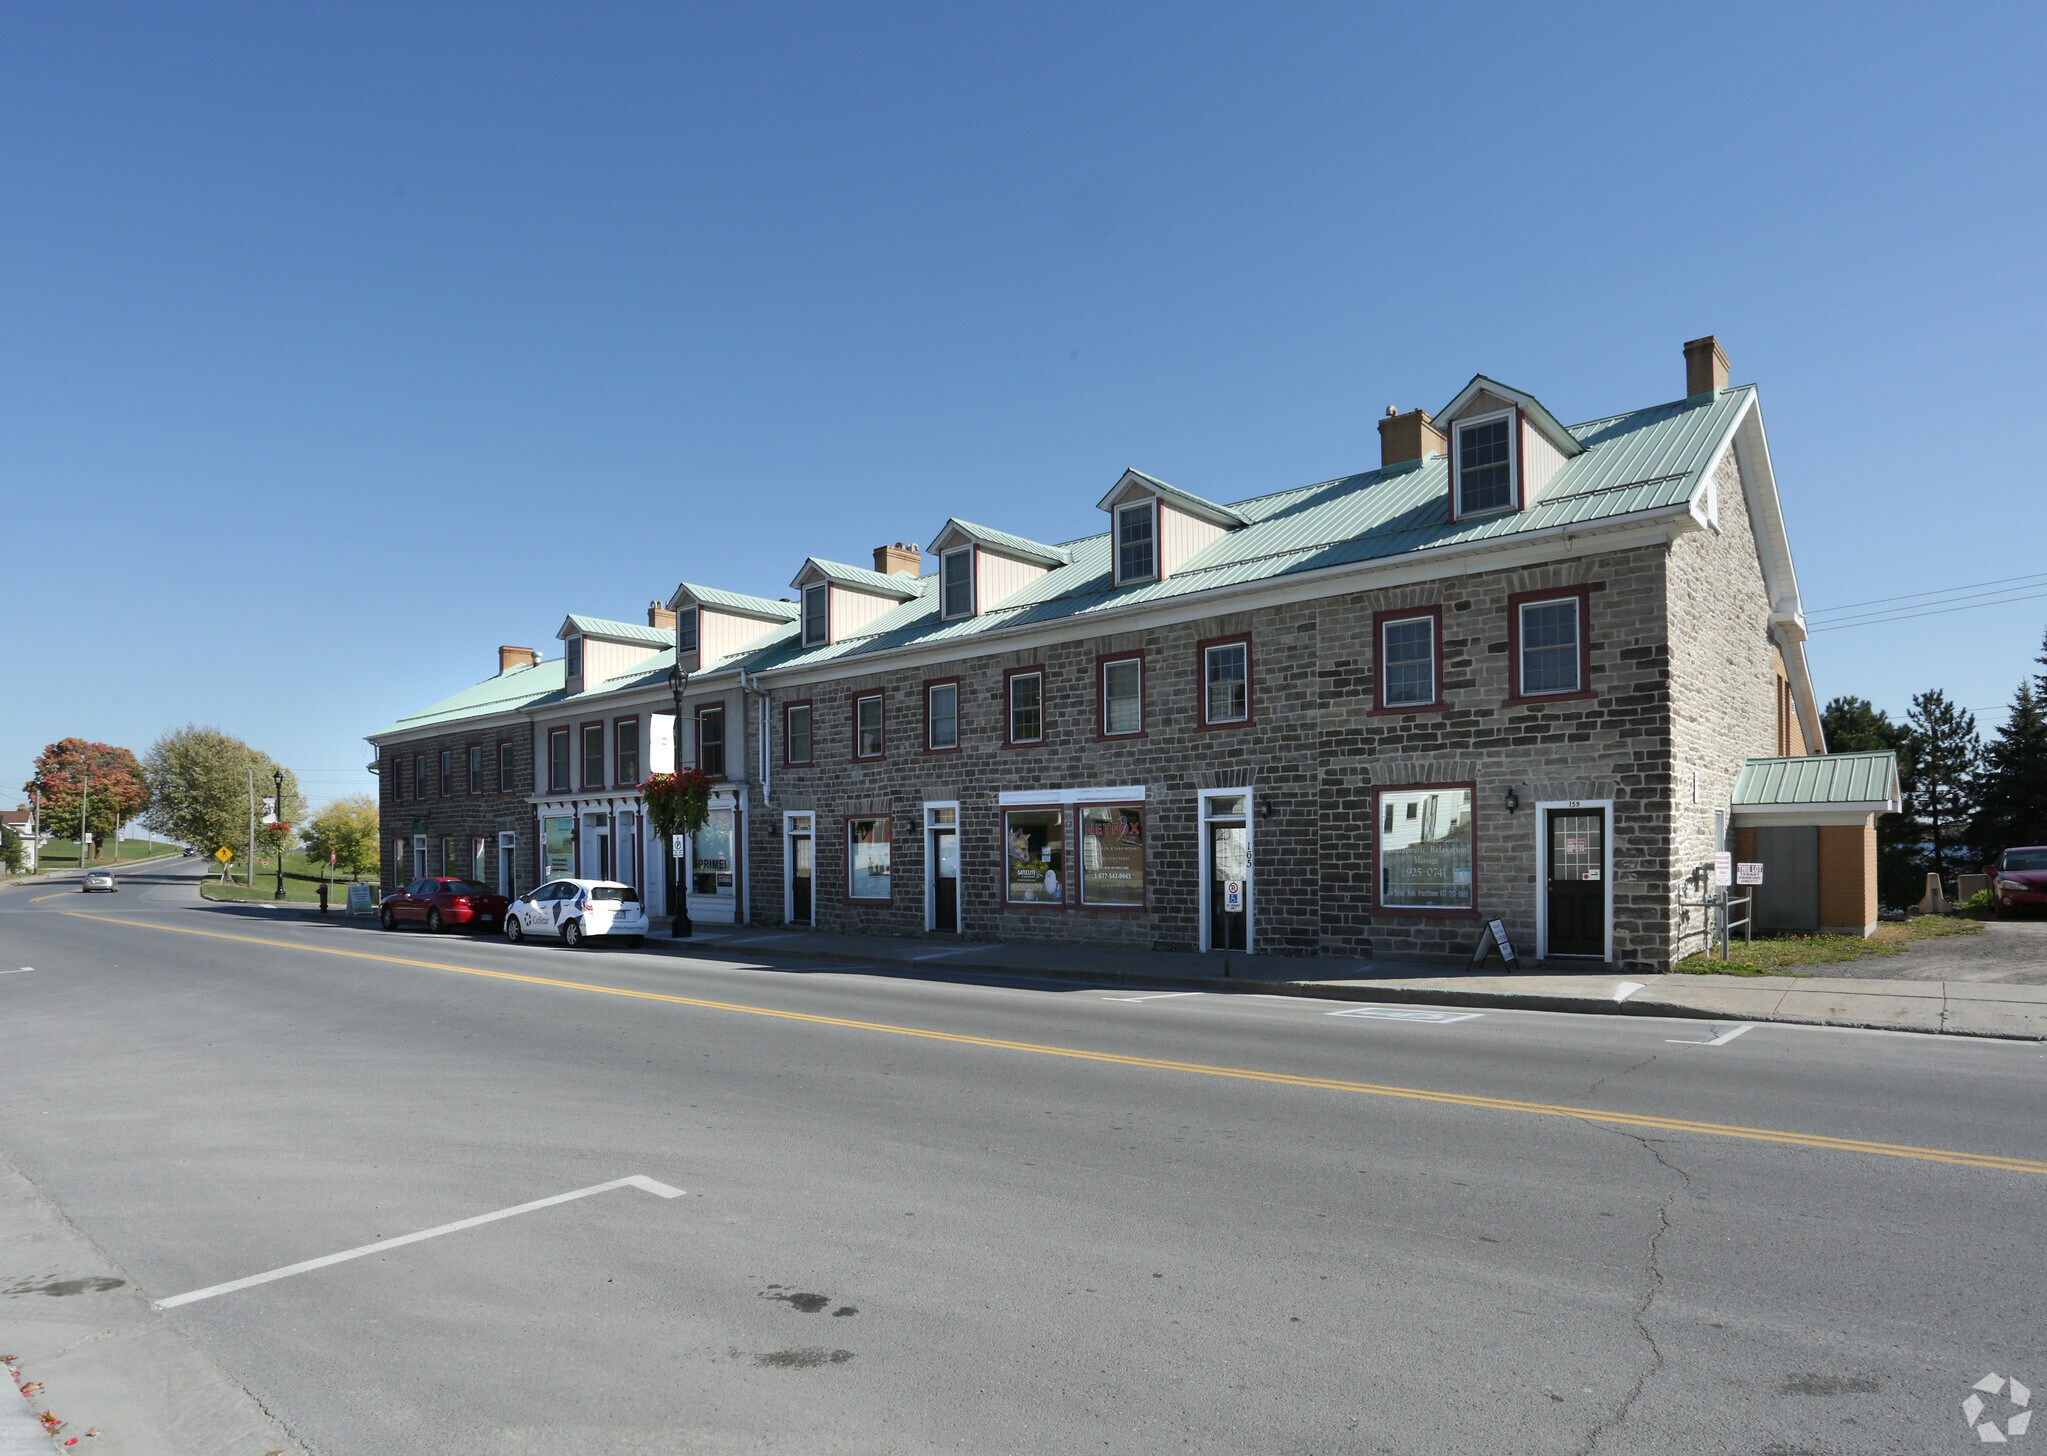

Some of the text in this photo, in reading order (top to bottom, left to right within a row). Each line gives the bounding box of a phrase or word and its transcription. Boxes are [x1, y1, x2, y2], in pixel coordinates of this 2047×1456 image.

[1085, 822, 1140, 836] NETFOX
[1430, 845, 1467, 854] Relaxation
[699, 859, 727, 869] PRIME!
[1413, 856, 1439, 865] Massage
[1406, 867, 1446, 877] 925-0741
[1738, 865, 1762, 873] THIS LOT
[533, 916, 549, 925] CoStar
